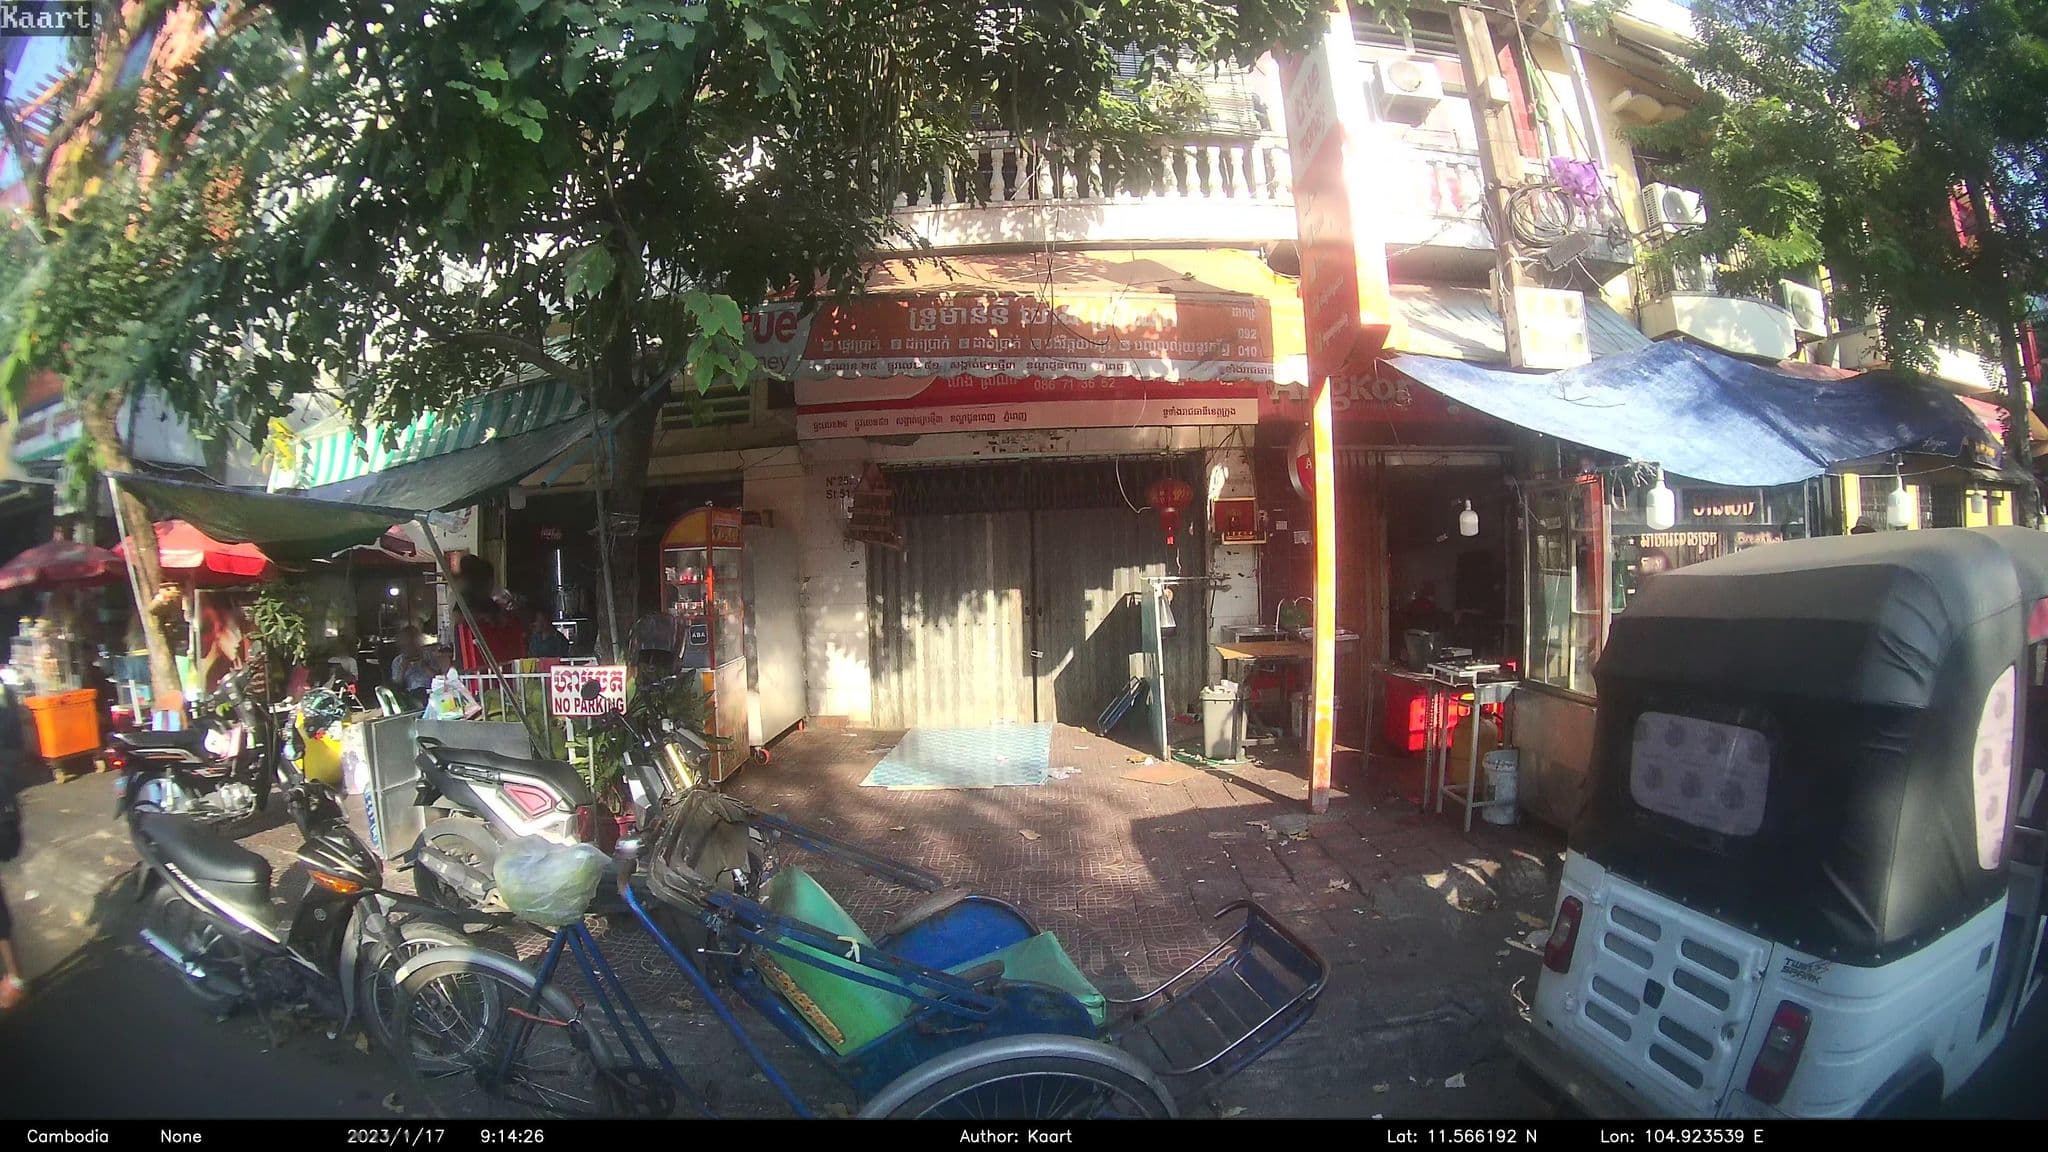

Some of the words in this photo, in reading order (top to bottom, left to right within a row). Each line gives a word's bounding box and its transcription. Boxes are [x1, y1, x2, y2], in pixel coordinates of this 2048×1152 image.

[1238, 328, 1257, 340] 092
[1238, 346, 1257, 357] 010
[1034, 378, 1056, 391] 086
[1062, 378, 1074, 390] 71
[1081, 378, 1095, 390] 36
[1101, 377, 1116, 389] 52
[554, 697, 571, 713] NO
[574, 697, 624, 713] PARKING
